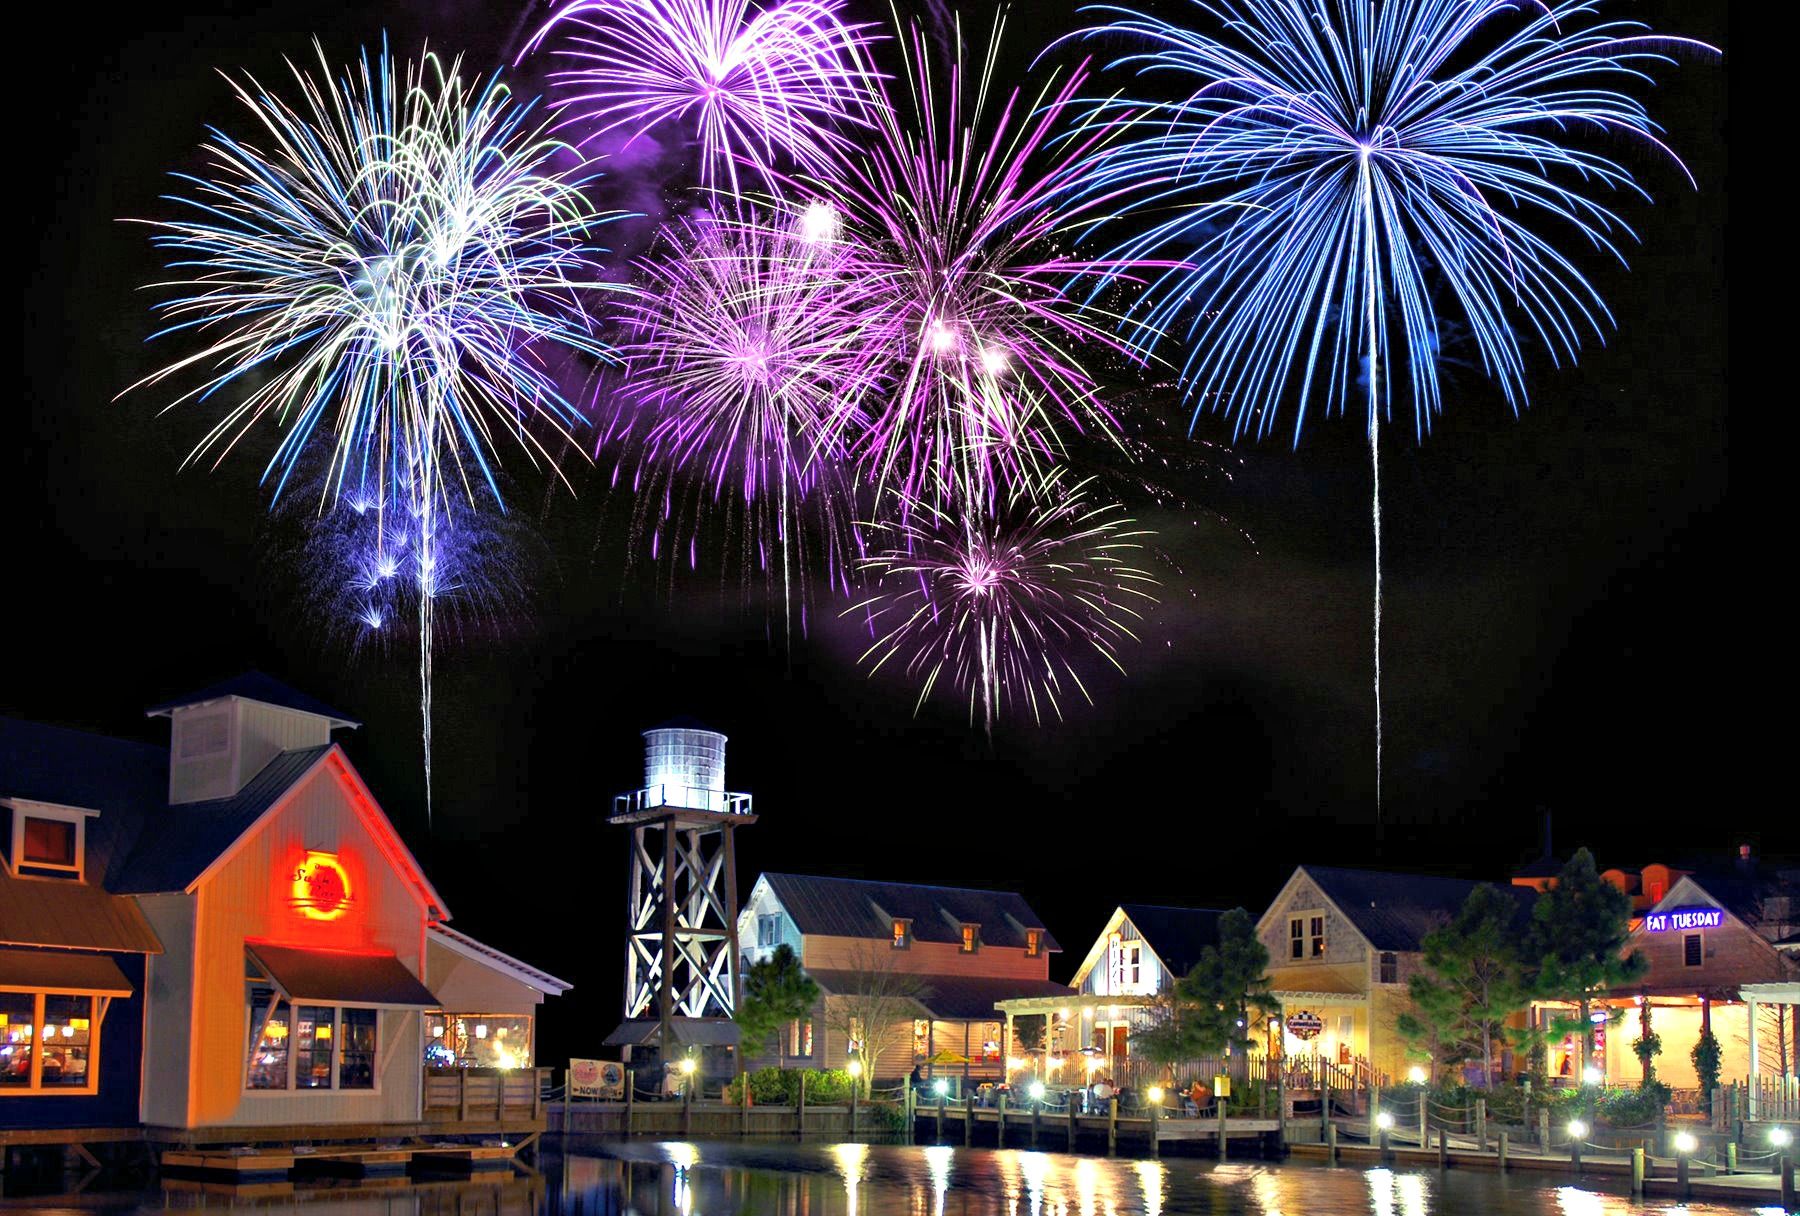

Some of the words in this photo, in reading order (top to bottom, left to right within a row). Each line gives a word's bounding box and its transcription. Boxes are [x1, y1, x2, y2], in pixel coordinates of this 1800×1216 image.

[1646, 915, 1667, 931] FAT
[1671, 911, 1721, 930] TUESDAY
[579, 1086, 599, 1095] NOW
